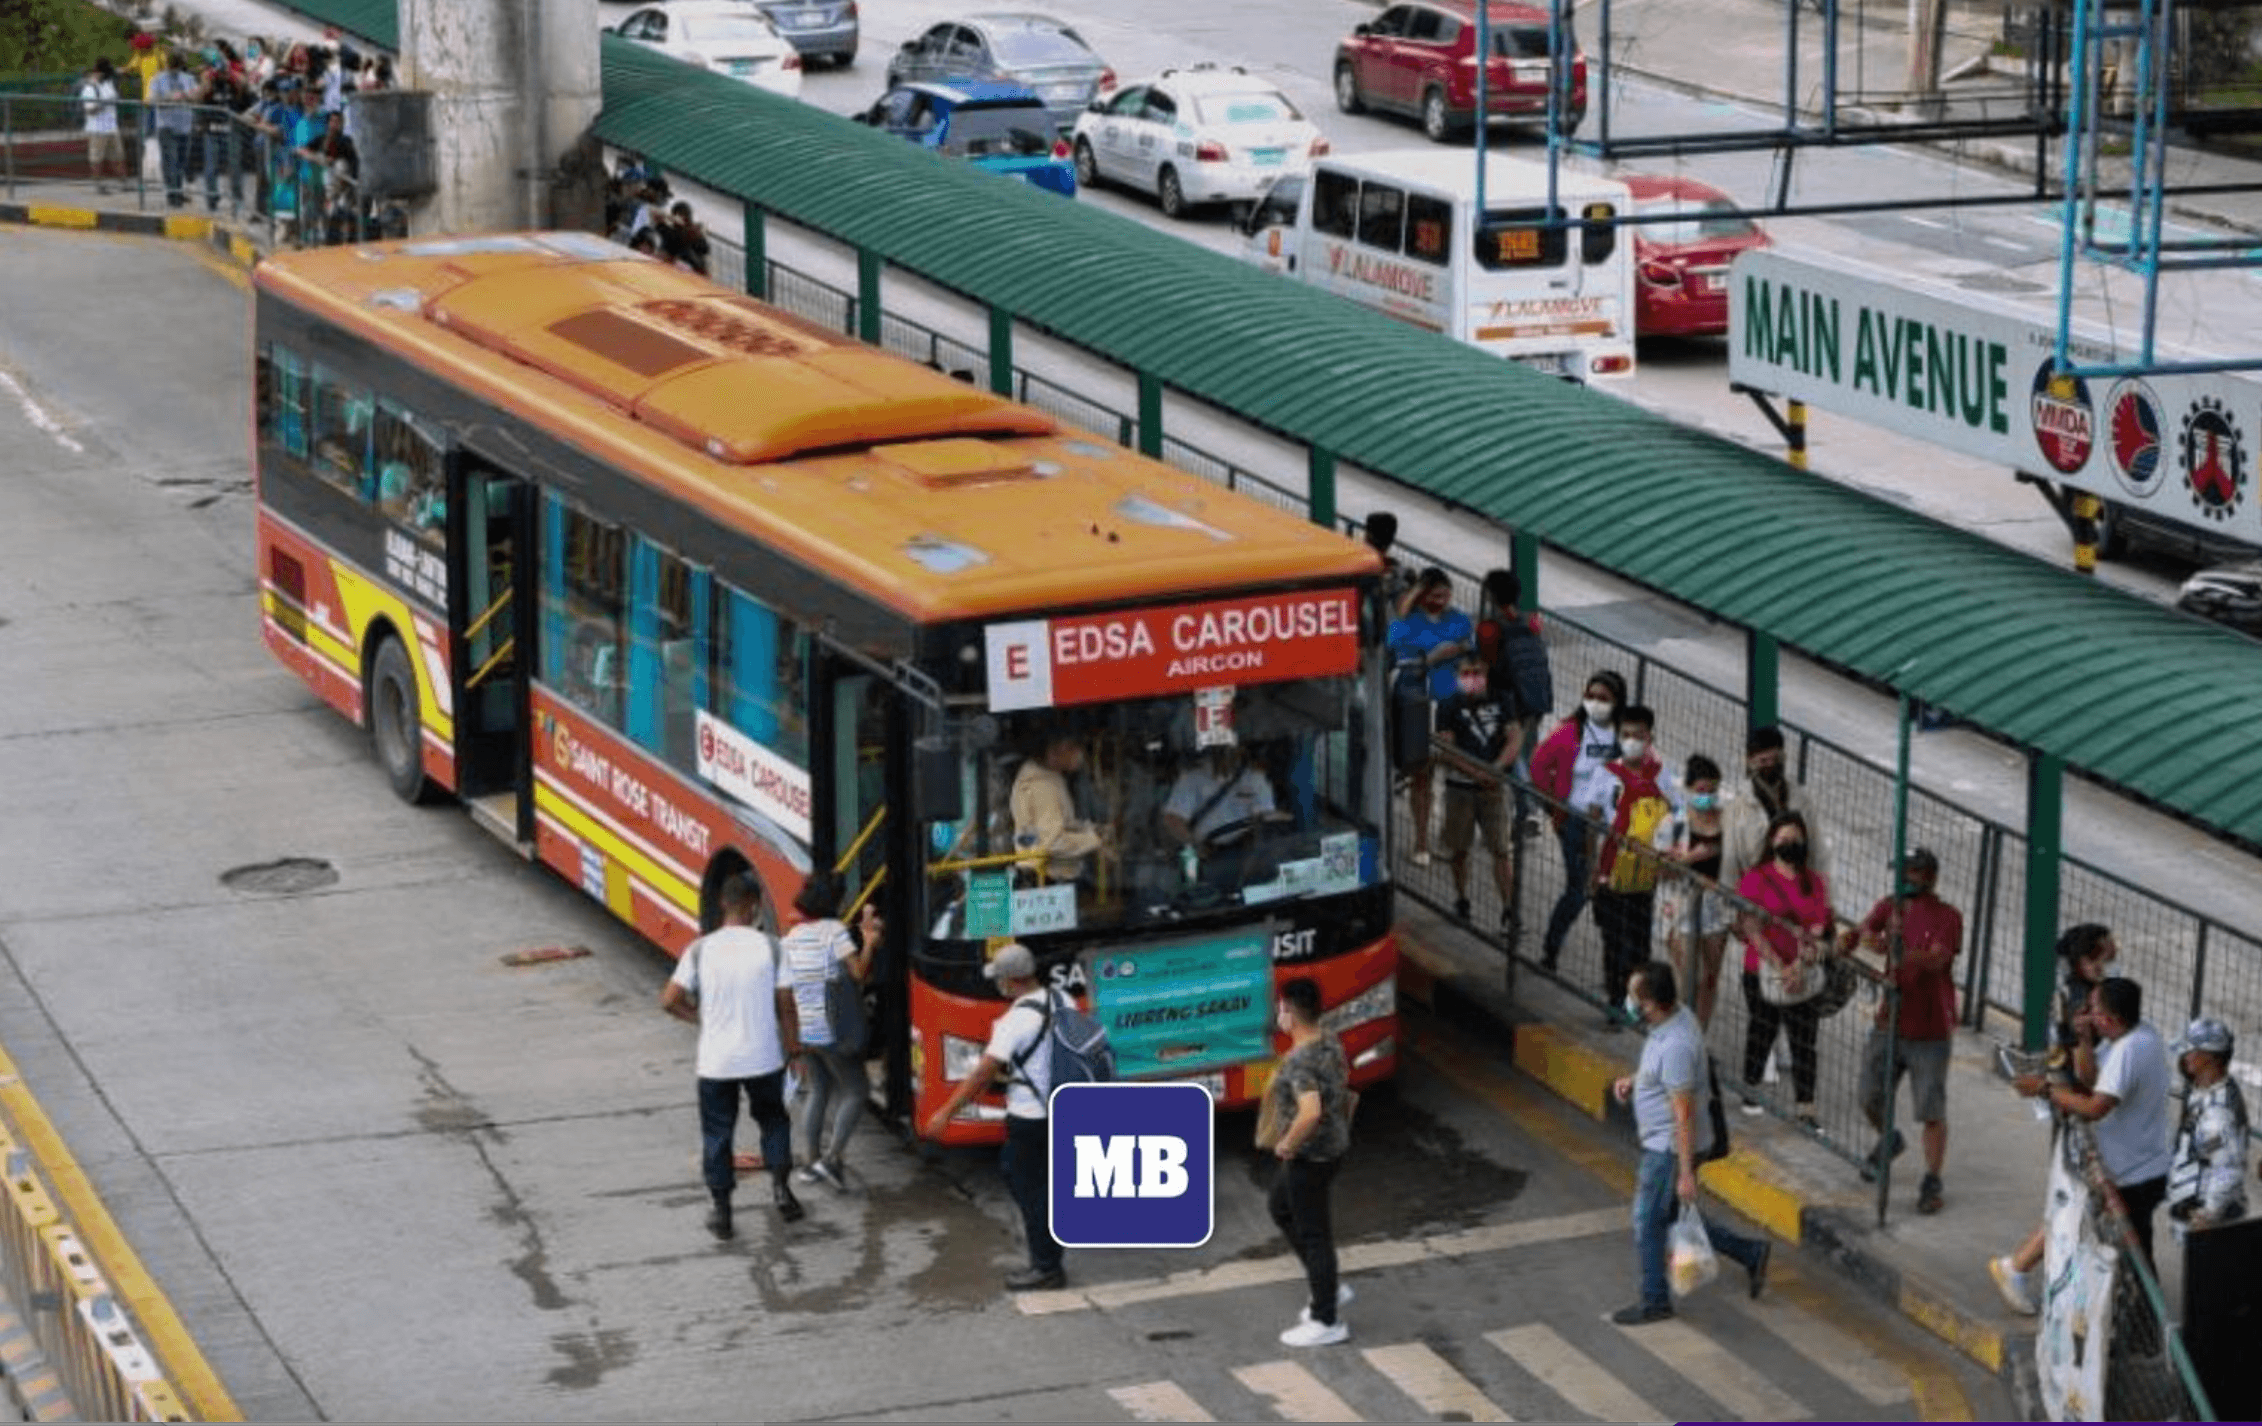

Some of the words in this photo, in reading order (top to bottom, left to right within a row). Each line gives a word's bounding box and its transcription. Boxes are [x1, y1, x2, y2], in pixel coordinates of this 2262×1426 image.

[1745, 275, 1841, 384] MAIN
[1853, 306, 2009, 435] AVENUE
[2036, 399, 2090, 437] MMDA
[1006, 644, 1030, 680] E
[1055, 619, 1156, 664] EDSA
[1171, 600, 1358, 652] CAROUSEL
[1167, 651, 1263, 677] AIRCON
[568, 738, 610, 791] SAINT
[611, 765, 650, 819] ROSE
[651, 791, 711, 858] TRANSIT
[751, 759, 810, 819] CAROUSE
